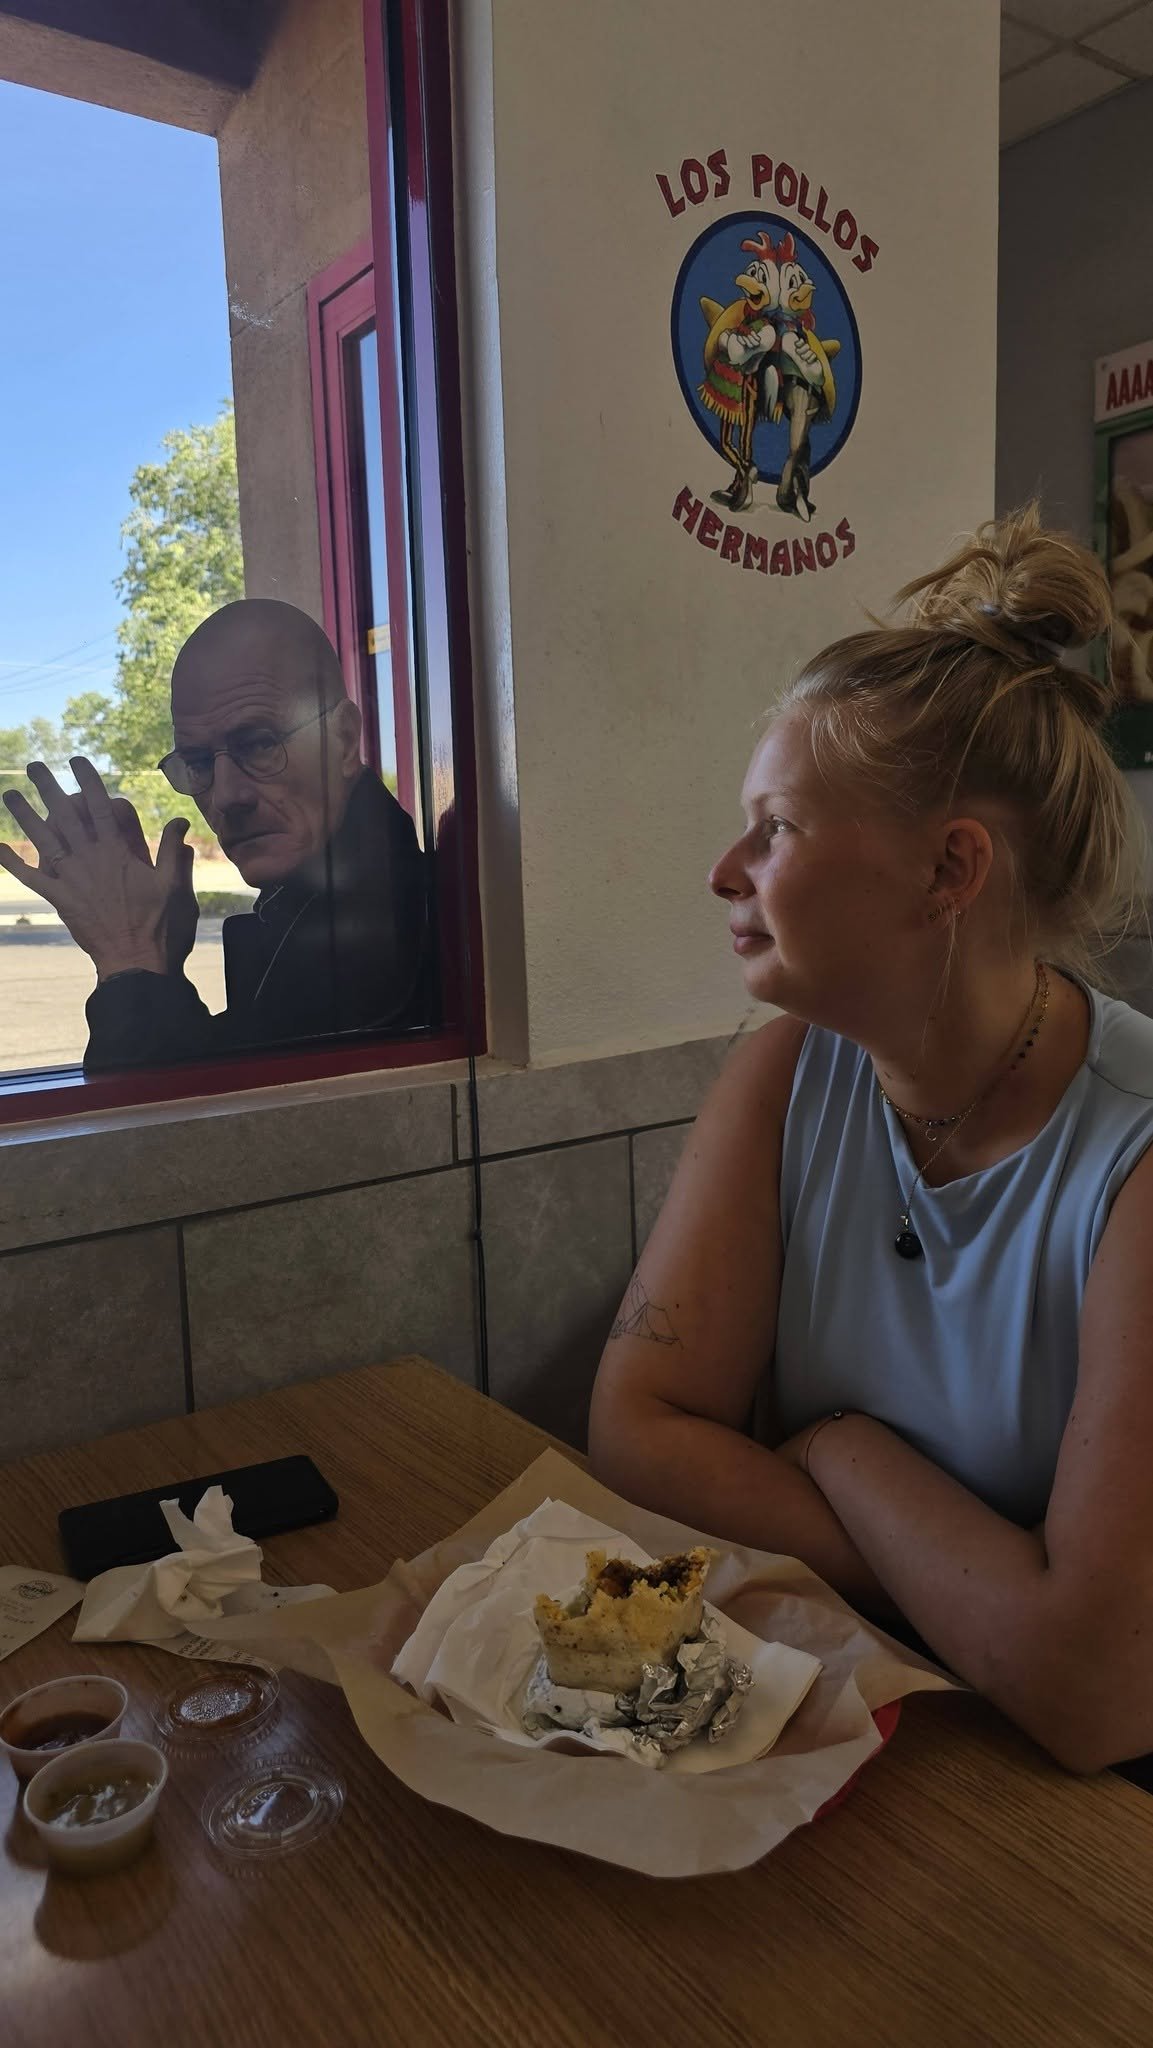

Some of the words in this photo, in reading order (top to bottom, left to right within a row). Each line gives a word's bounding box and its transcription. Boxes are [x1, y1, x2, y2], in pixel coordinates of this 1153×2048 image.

[656, 148, 731, 218] LOS
[751, 153, 880, 273] POLLOS
[672, 485, 856, 577] HERMANOS
